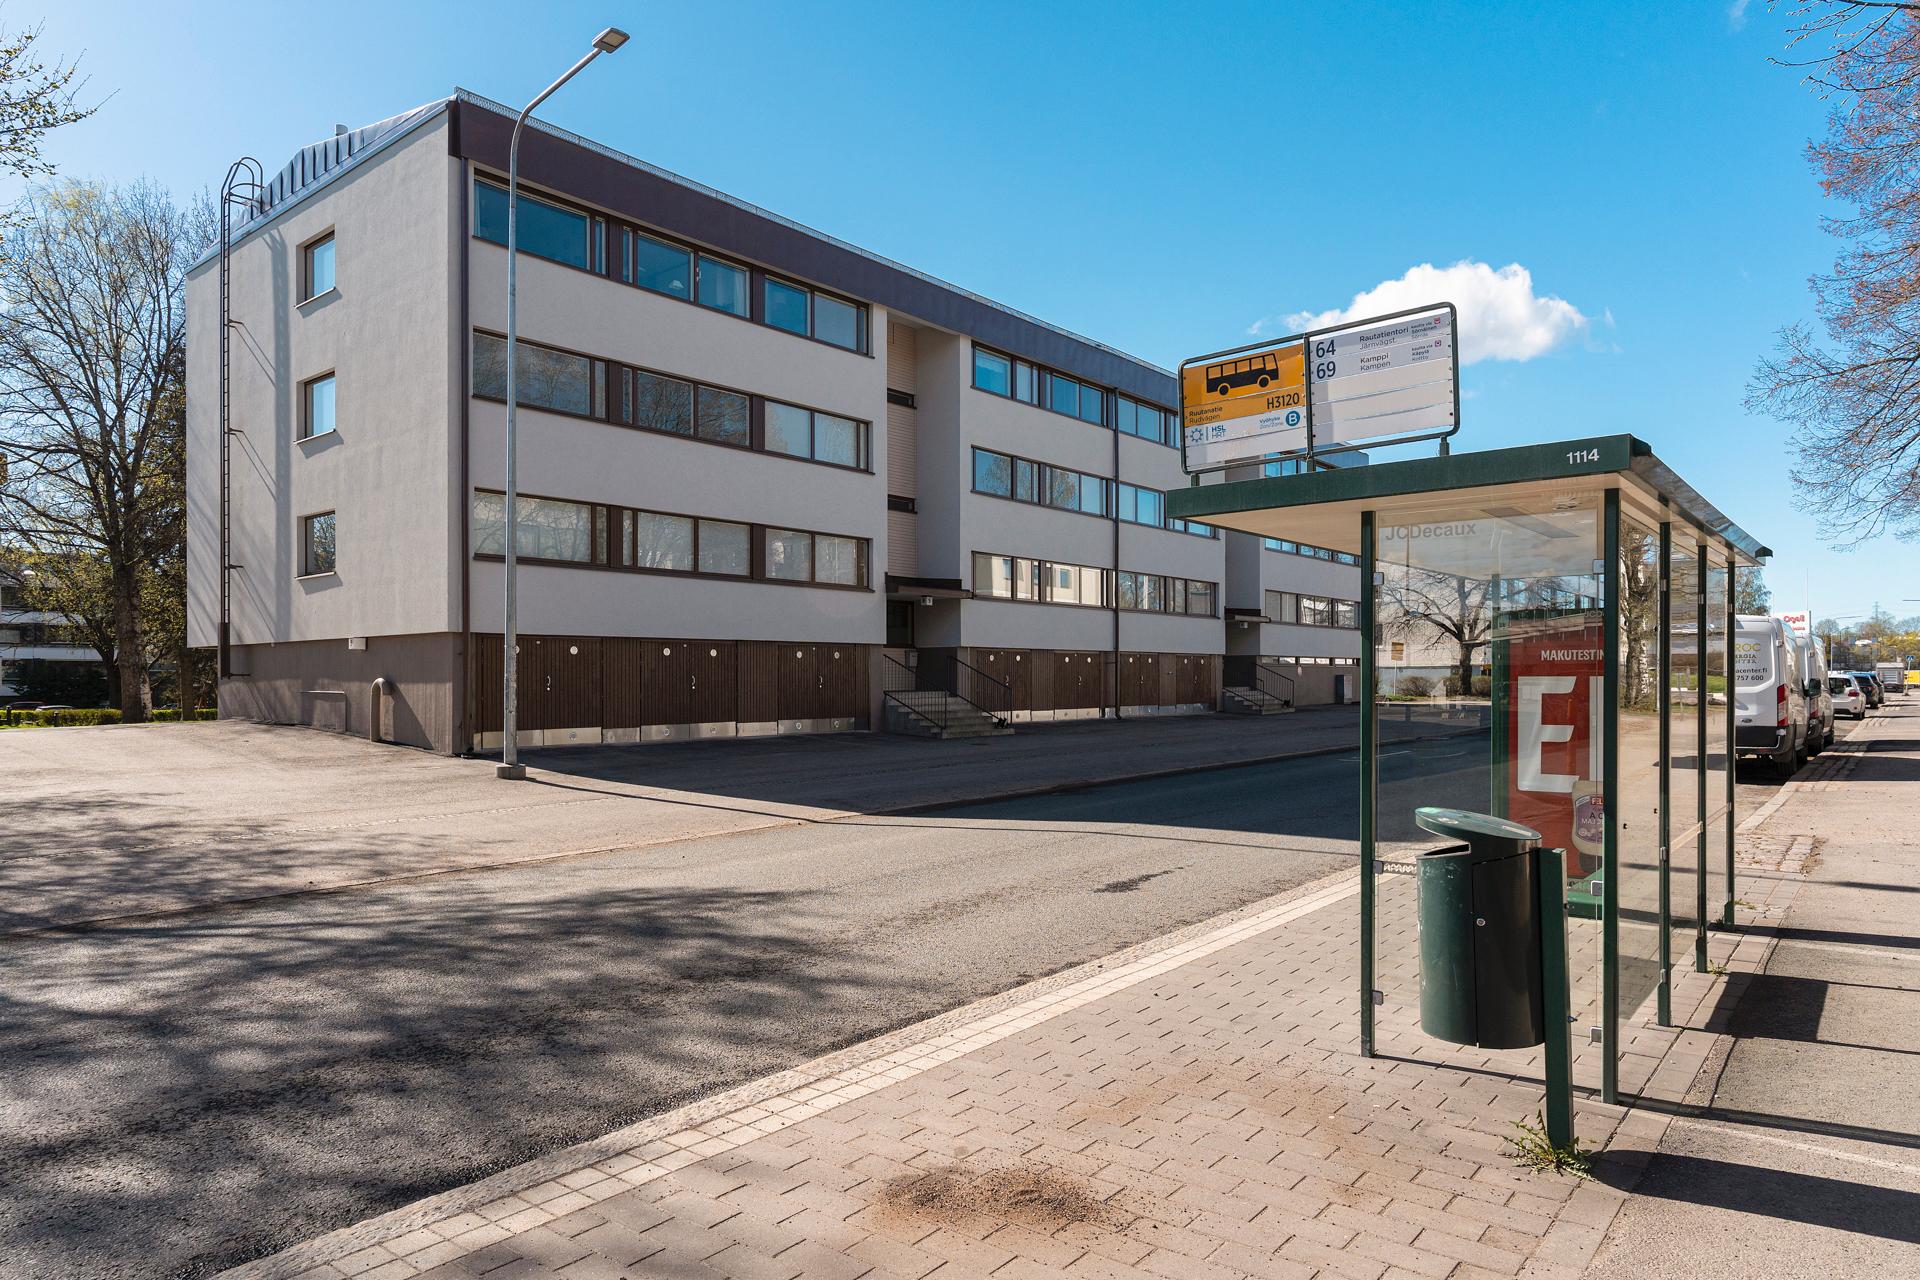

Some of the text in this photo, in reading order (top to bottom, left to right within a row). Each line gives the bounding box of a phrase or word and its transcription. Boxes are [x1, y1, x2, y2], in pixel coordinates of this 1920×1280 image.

[1360, 327, 1409, 343] Rautatientori
[1315, 340, 1336, 358] 64
[1360, 353, 1389, 365] Kamppi
[1316, 361, 1336, 379] 69
[1360, 361, 1391, 373] Kampen
[1267, 392, 1300, 410] H3120
[1189, 406, 1223, 417] Ruutanatie
[1288, 414, 1297, 423] B
[1211, 425, 1227, 433] HSL
[1211, 431, 1226, 439] HRT
[1567, 448, 1600, 465] 1114
[1386, 522, 1477, 542] JCDecaux
